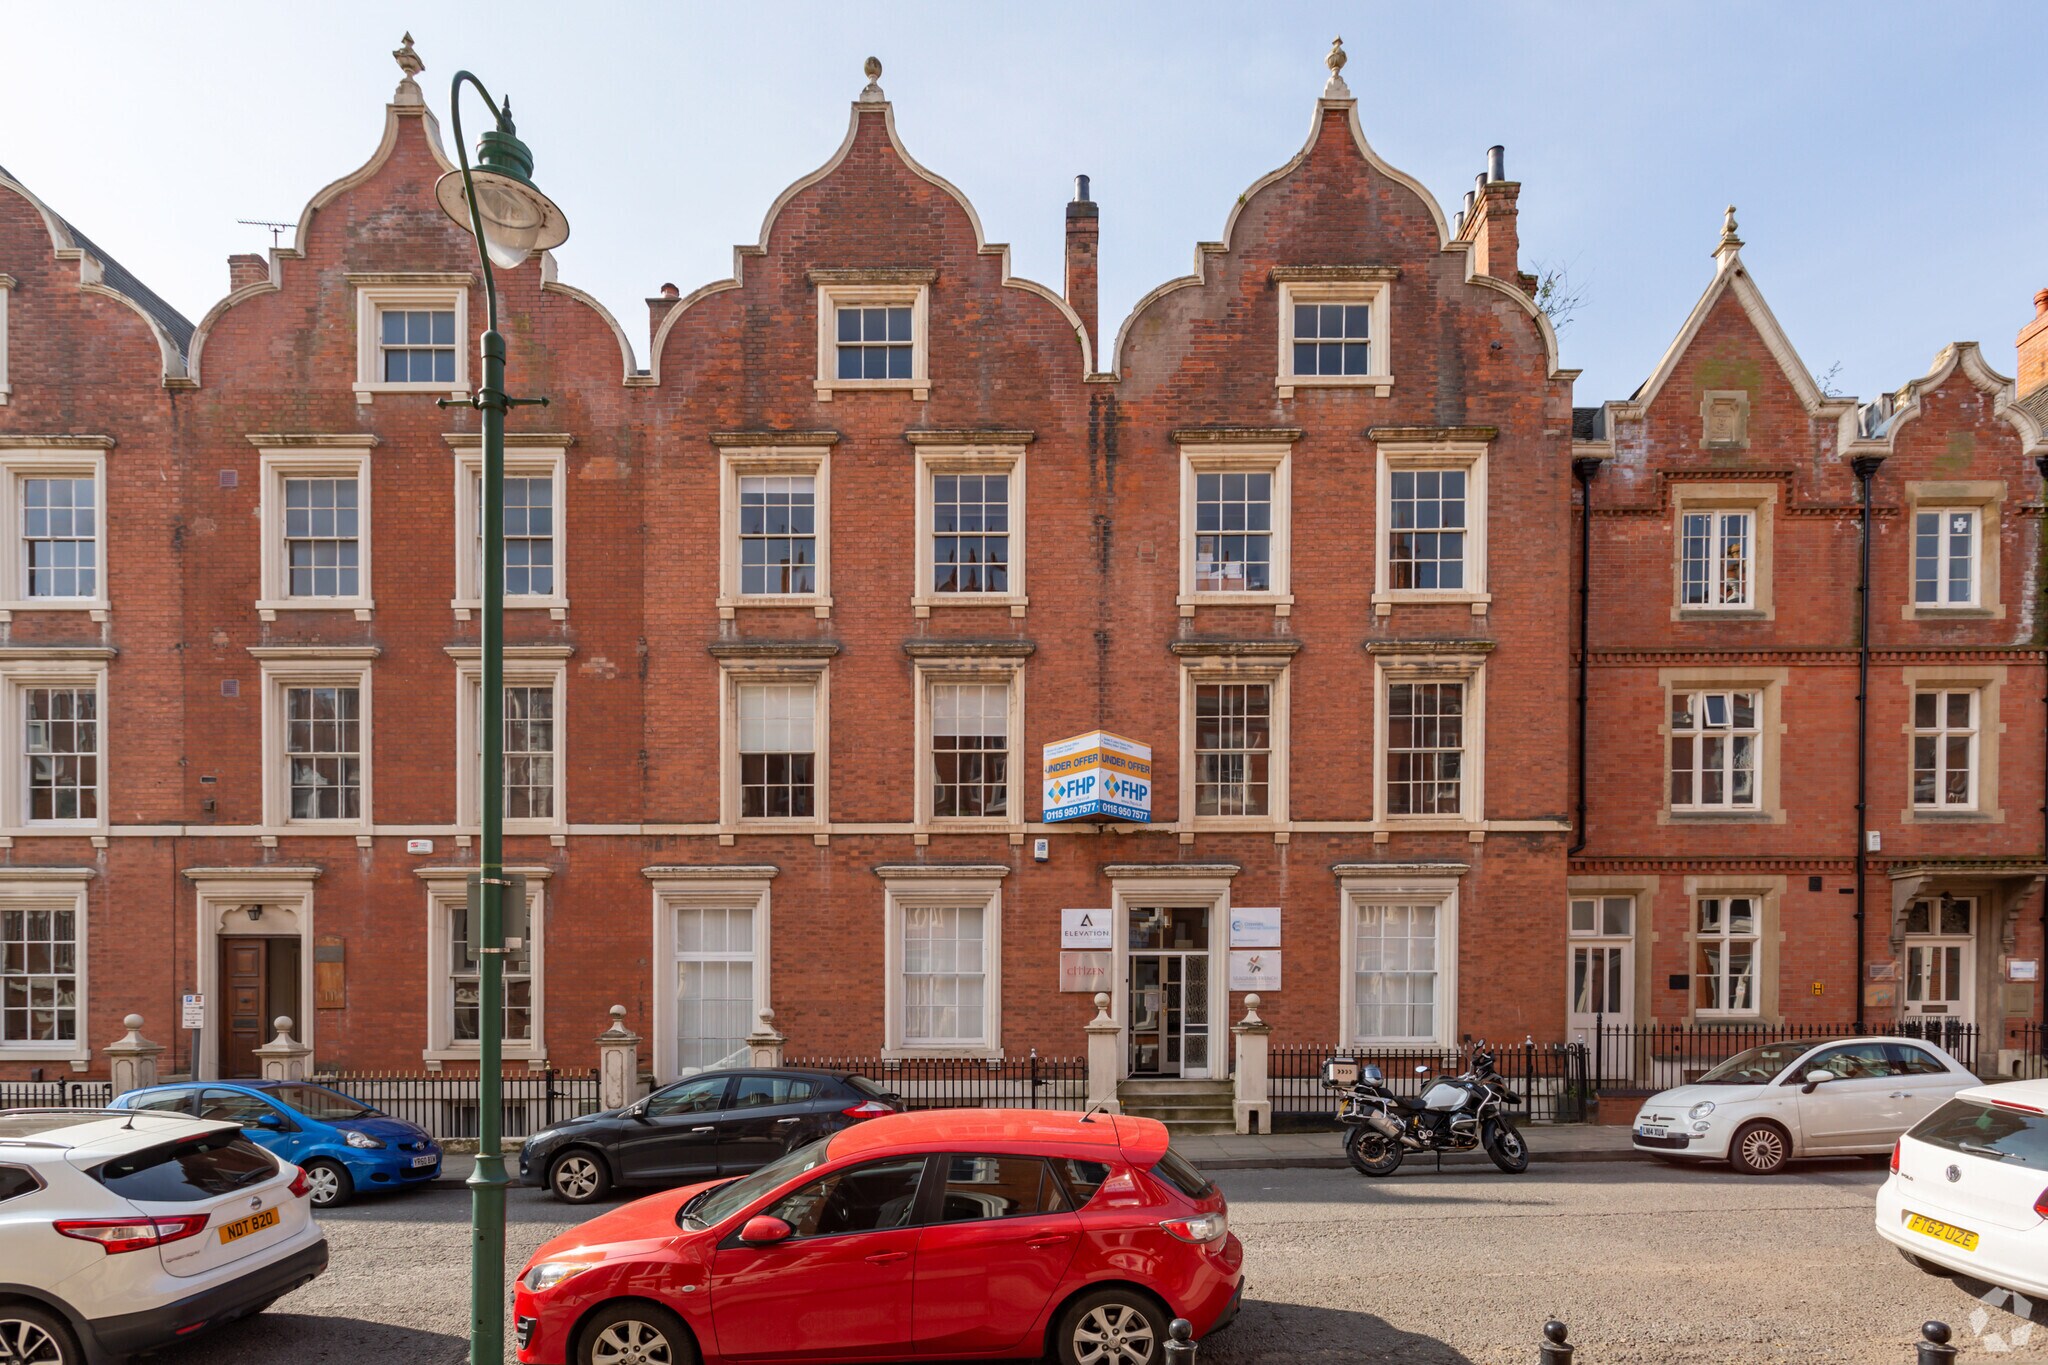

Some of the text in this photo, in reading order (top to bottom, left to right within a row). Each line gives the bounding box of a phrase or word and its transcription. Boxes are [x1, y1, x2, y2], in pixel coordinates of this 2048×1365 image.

[1046, 753, 1099, 774] UNDER OFFER
[1102, 753, 1150, 774] UNDER OFFER
[1067, 776, 1096, 798] FHP
[1121, 780, 1148, 801] FHP
[1046, 802, 1096, 820] 0115 950 7577
[1102, 803, 1148, 820] 0115 950 7577
[1066, 966, 1104, 976] CITIZEN
[227, 1212, 272, 1240] NDT 820
[1912, 1216, 1974, 1247] FT62 UZE
